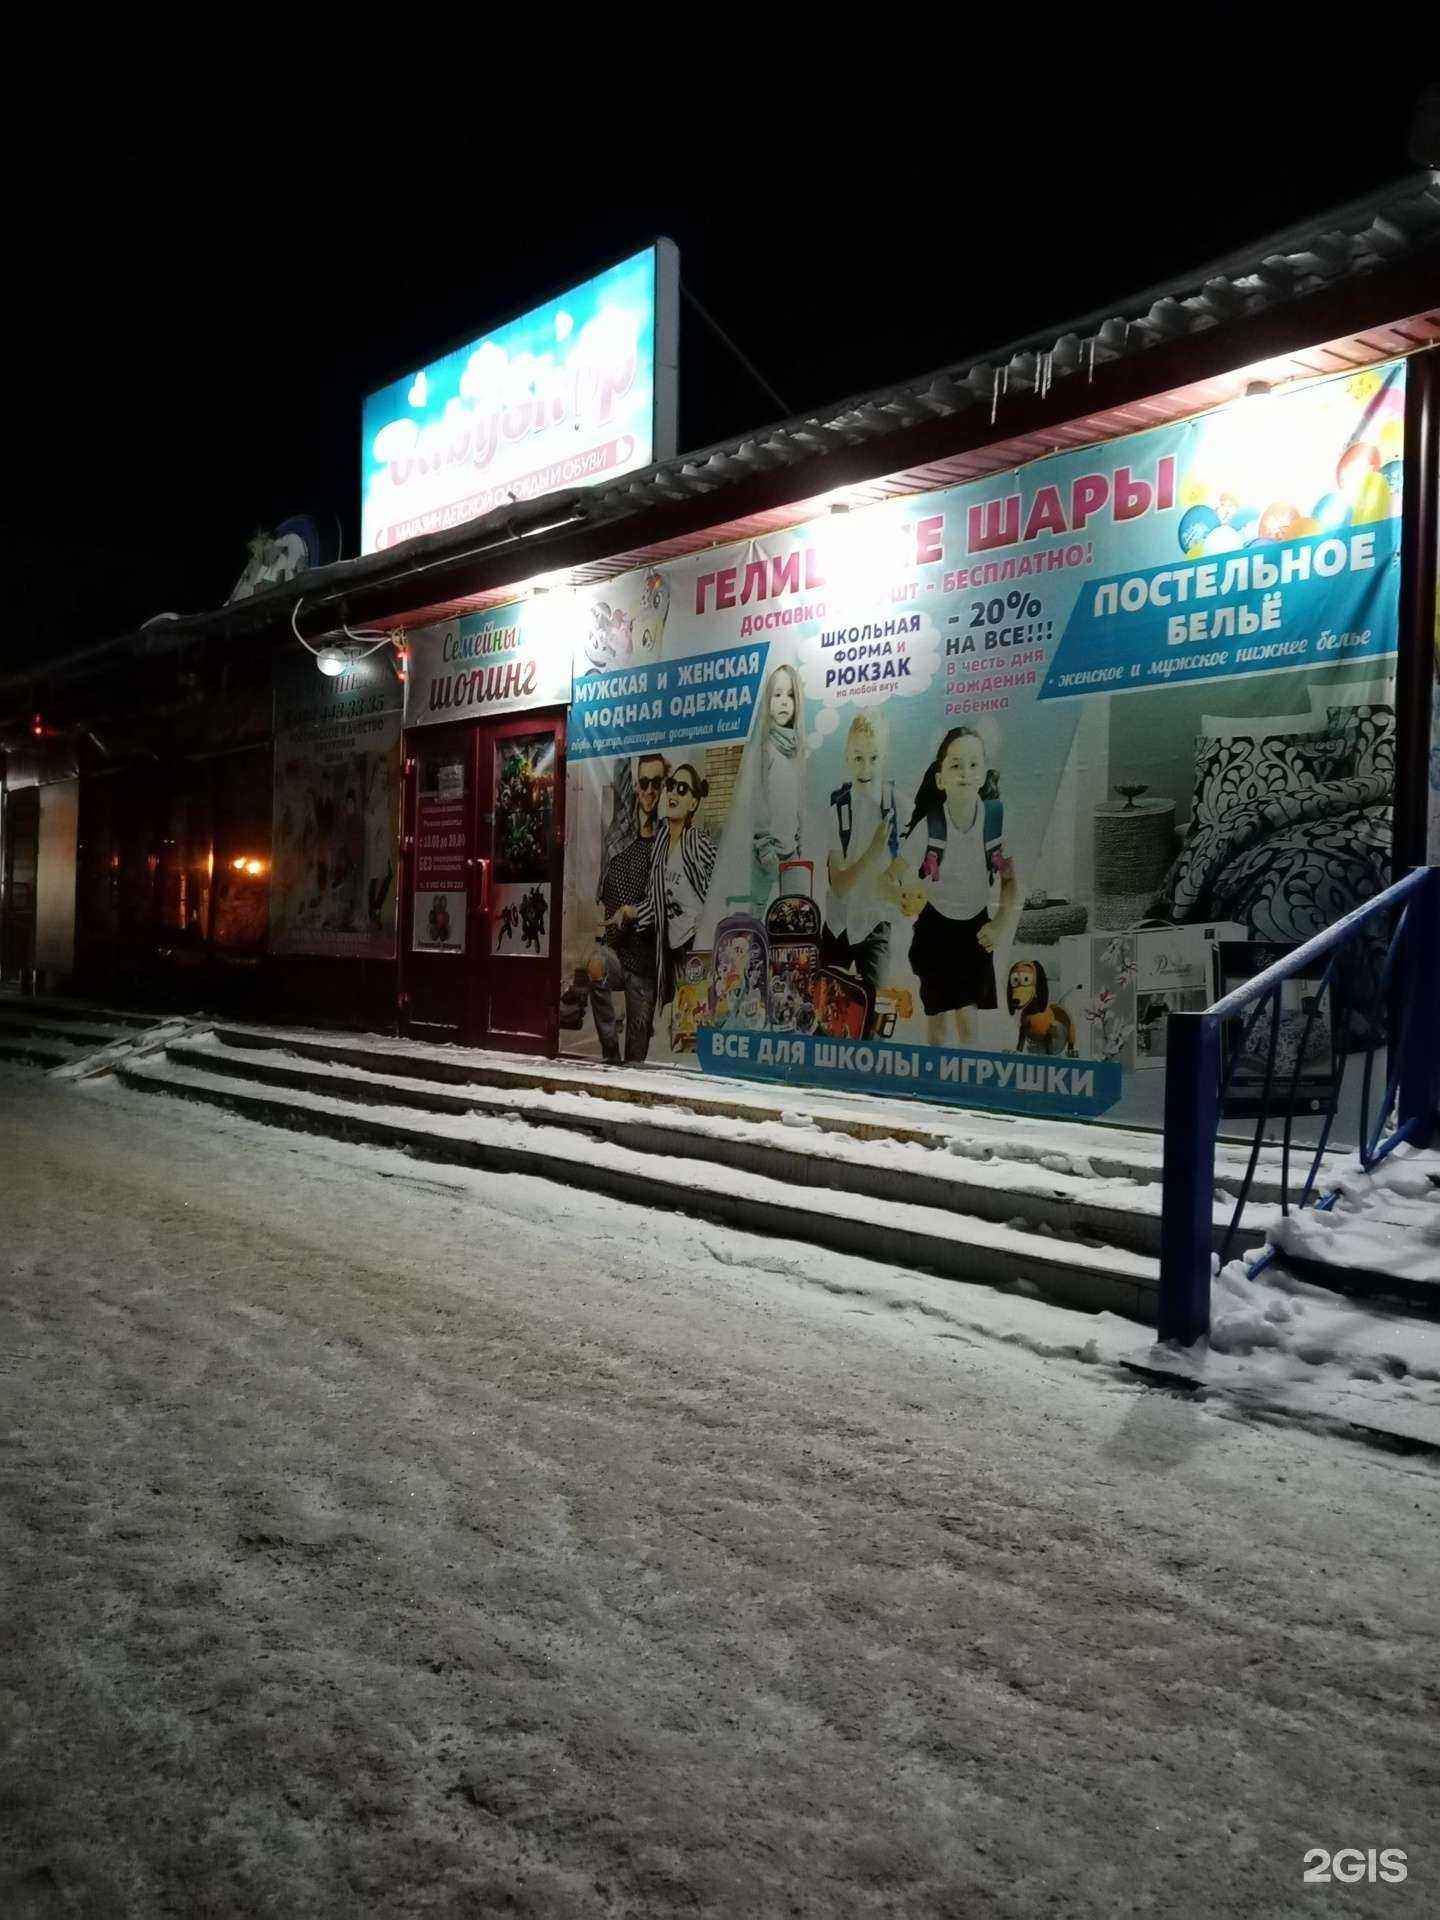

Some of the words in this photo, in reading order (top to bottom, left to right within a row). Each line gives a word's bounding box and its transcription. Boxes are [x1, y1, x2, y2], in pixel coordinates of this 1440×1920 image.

[562, 451, 608, 480] ОБУВИ
[696, 515, 944, 616] ГЕЛИЕ
[967, 453, 1177, 555] ШАРЫ
[943, 542, 1094, 593] БЕСПЛАТНО!
[1093, 531, 1377, 618] ПОСТЕЛЬНОЕ
[820, 614, 921, 648] ШКОЛЬНАЯ
[969, 590, 1042, 628] 20%
[1167, 590, 1283, 646] БЕЛЬЁ
[834, 641, 893, 664] ФОРМА
[945, 635, 976, 656] НА
[984, 621, 1054, 650] ВСЕ!!!
[1010, 649, 1045, 668] дня
[1058, 665, 1125, 688] женское
[1130, 663, 1140, 677] и
[1147, 650, 1230, 679] мужское
[1236, 638, 1309, 663] нижнее
[1316, 628, 1372, 651] белье
[429, 660, 538, 711] шопинг
[574, 672, 648, 704] МУЖСКАЯ
[678, 652, 760, 687] ЖЕНСКАЯ
[825, 656, 912, 688] РЮКЗАК
[850, 683, 877, 696] любой
[584, 699, 663, 729] МОДНАЯ
[670, 685, 752, 718] ОДЕЖДА
[711, 1032, 749, 1059] ВСЕ
[758, 1038, 806, 1066] ДЛЯ
[814, 1043, 920, 1078] ШКОЛЫ
[939, 1055, 1095, 1097] ИГРУШКИ
